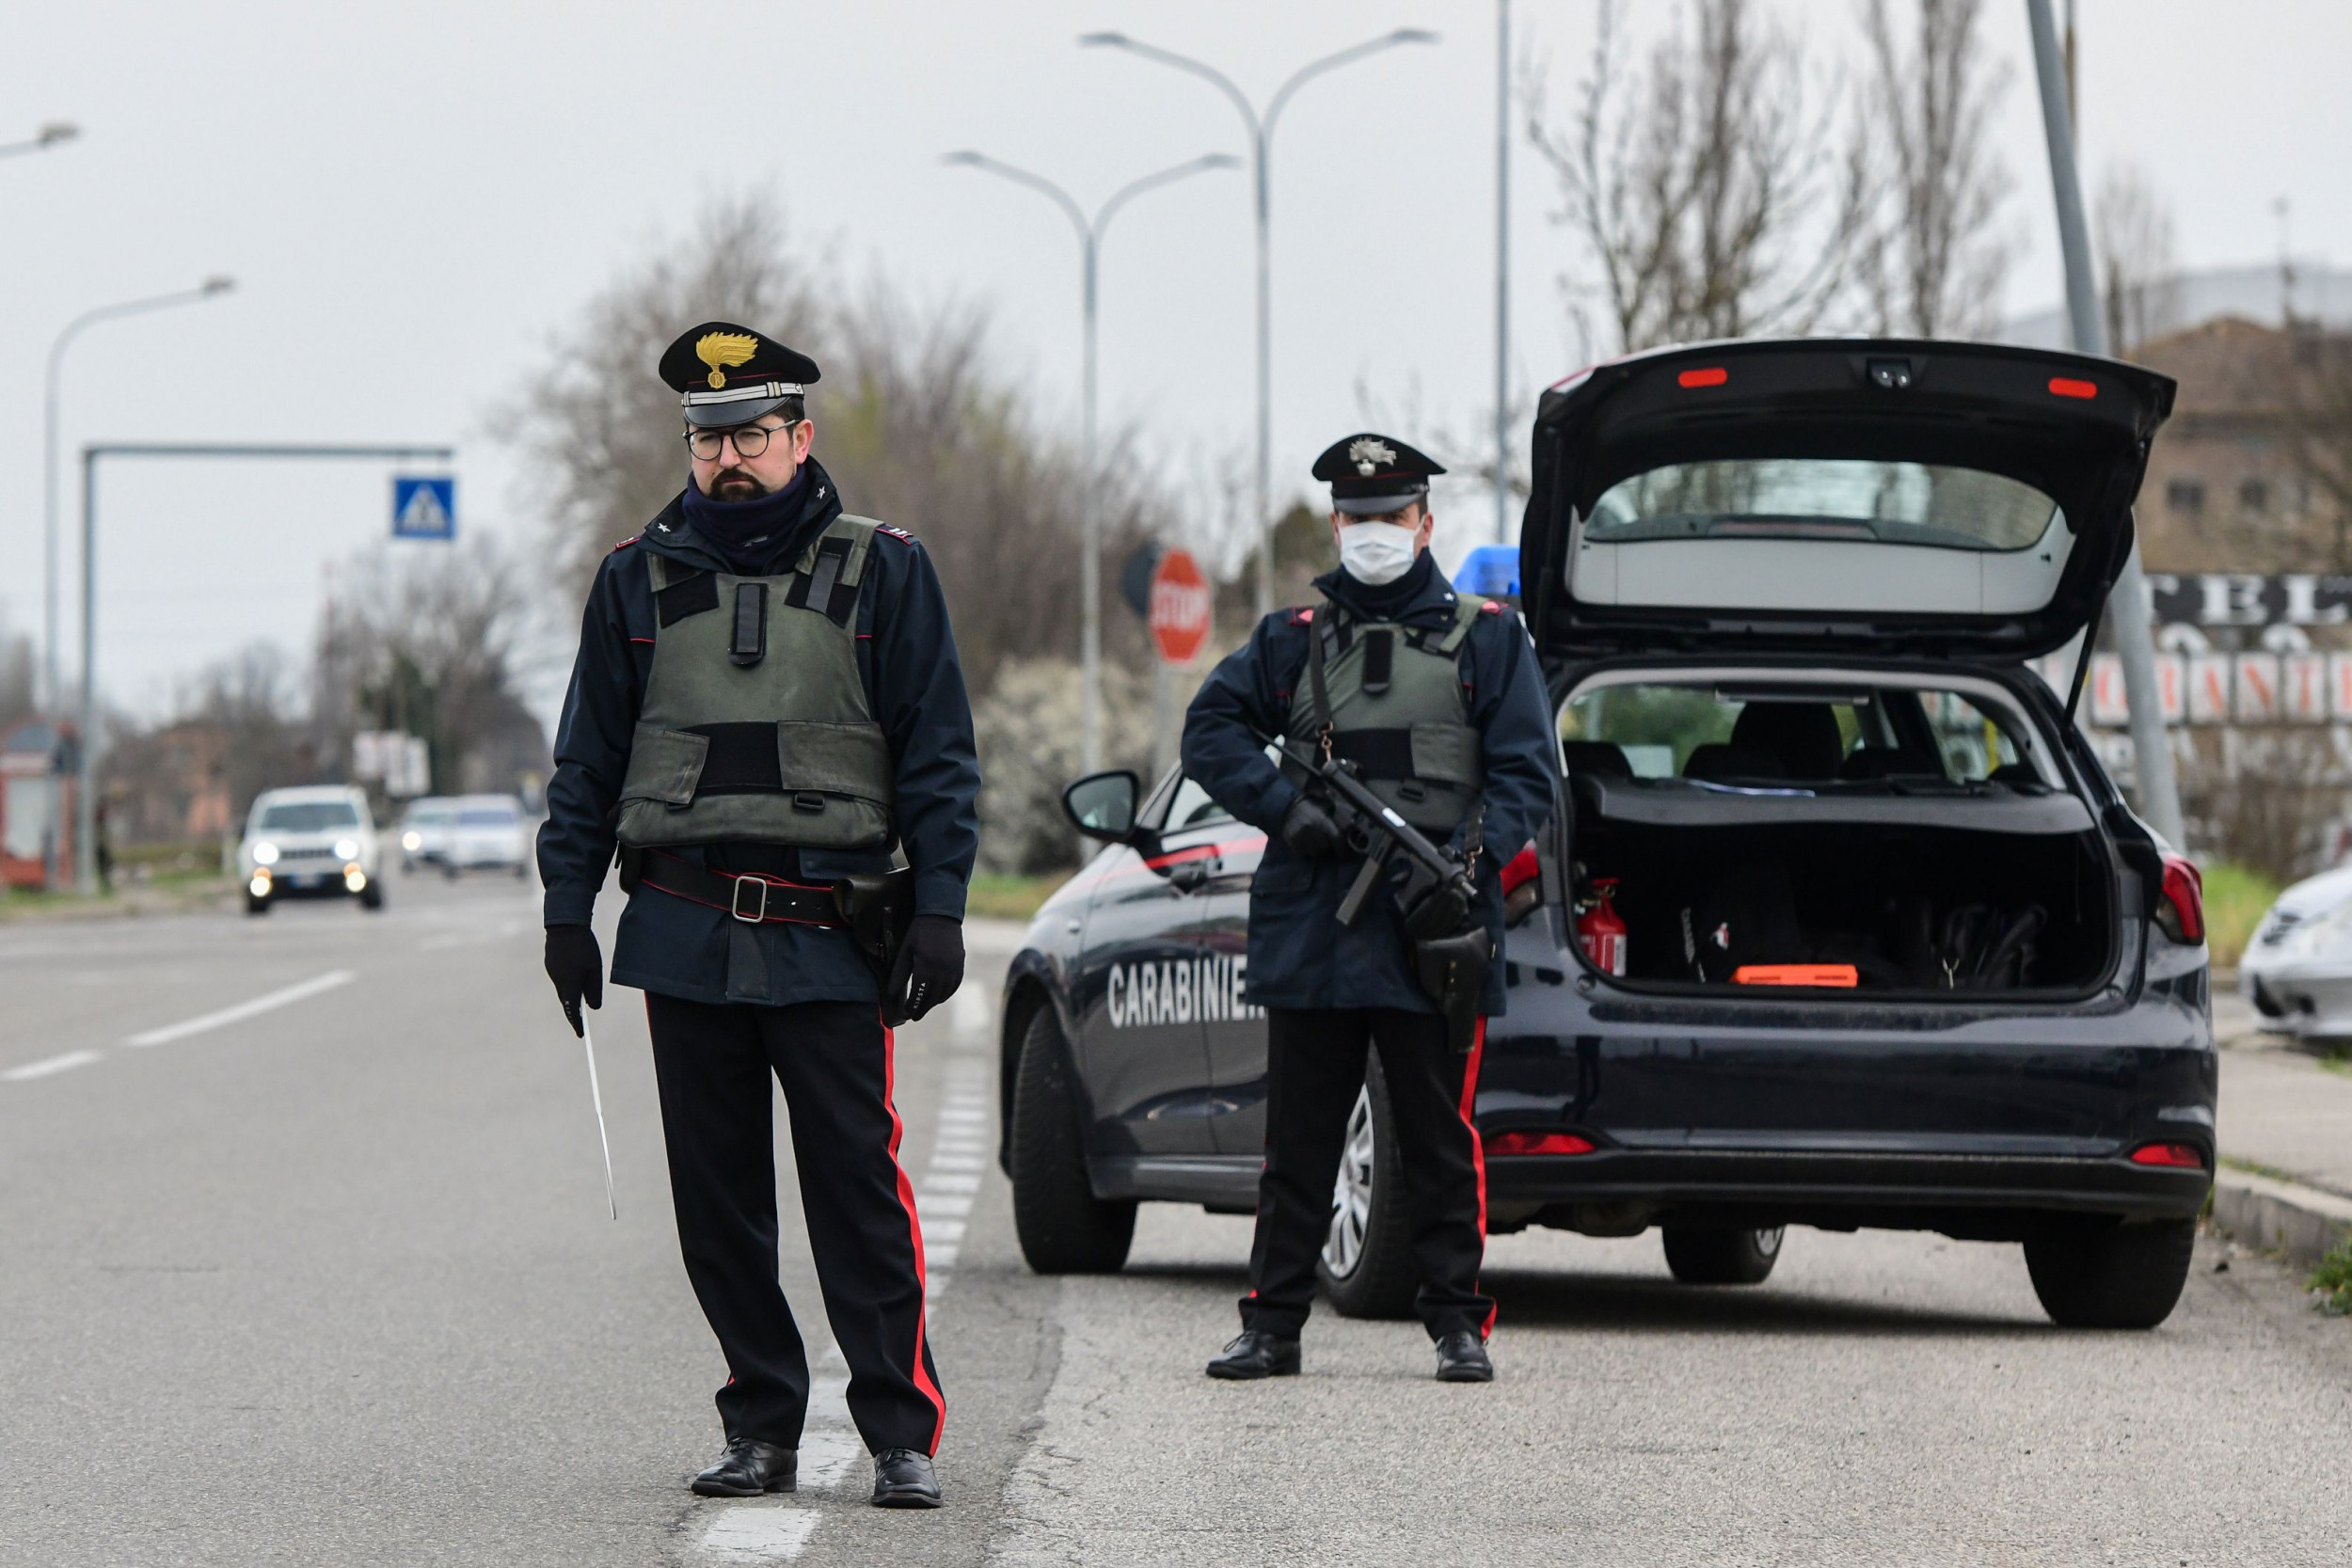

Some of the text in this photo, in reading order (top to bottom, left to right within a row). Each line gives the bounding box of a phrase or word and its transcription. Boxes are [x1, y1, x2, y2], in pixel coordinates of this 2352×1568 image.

[1152, 581, 1209, 628] STOP
[913, 982, 926, 1009] KIPSTA
[1107, 954, 1265, 1028] CARABINIE
